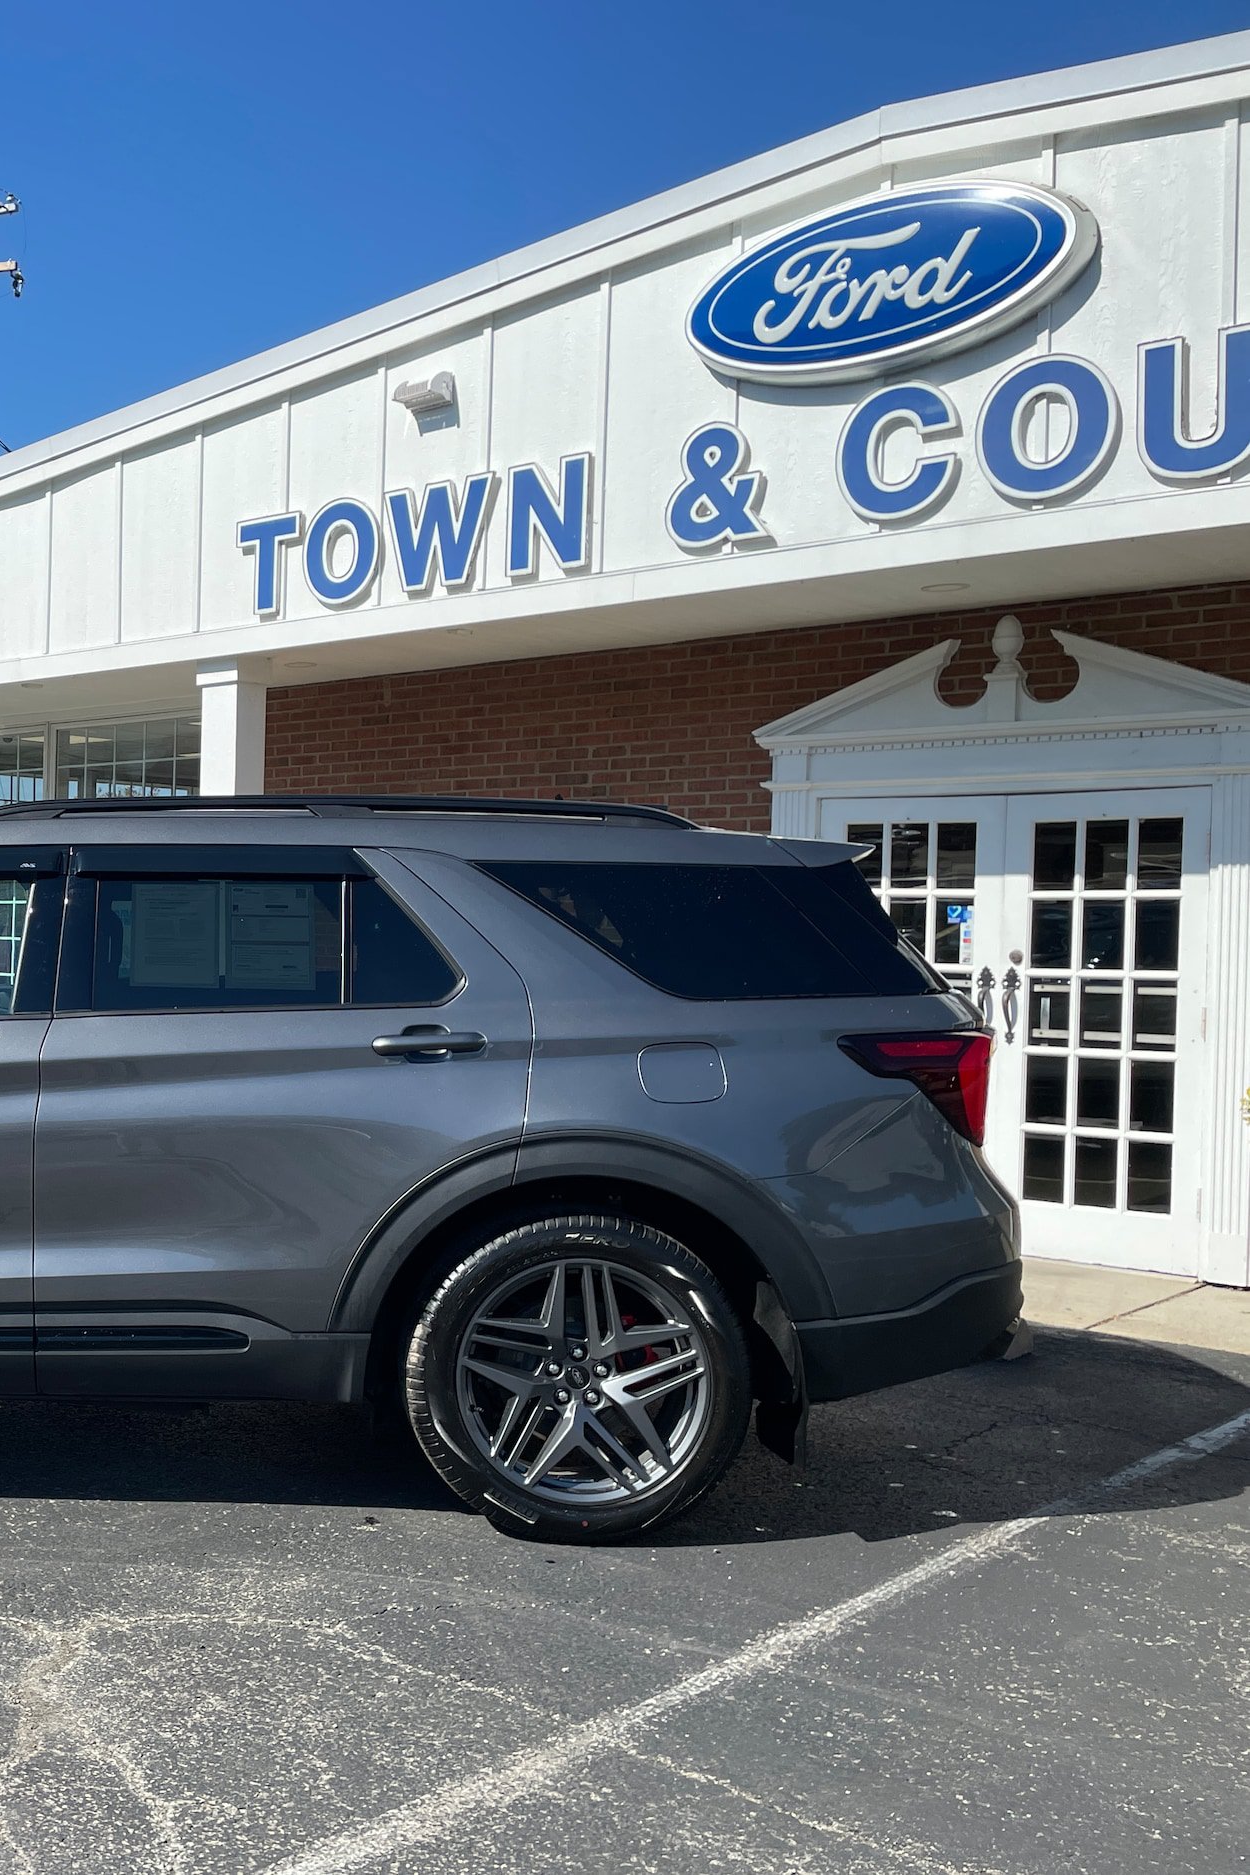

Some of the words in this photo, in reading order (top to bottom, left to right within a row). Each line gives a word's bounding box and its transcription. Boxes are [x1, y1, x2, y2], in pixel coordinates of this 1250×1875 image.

[753, 221, 981, 344] Ford
[236, 452, 591, 615] TOWN
[665, 421, 770, 549] &
[836, 325, 1250, 519] COU
